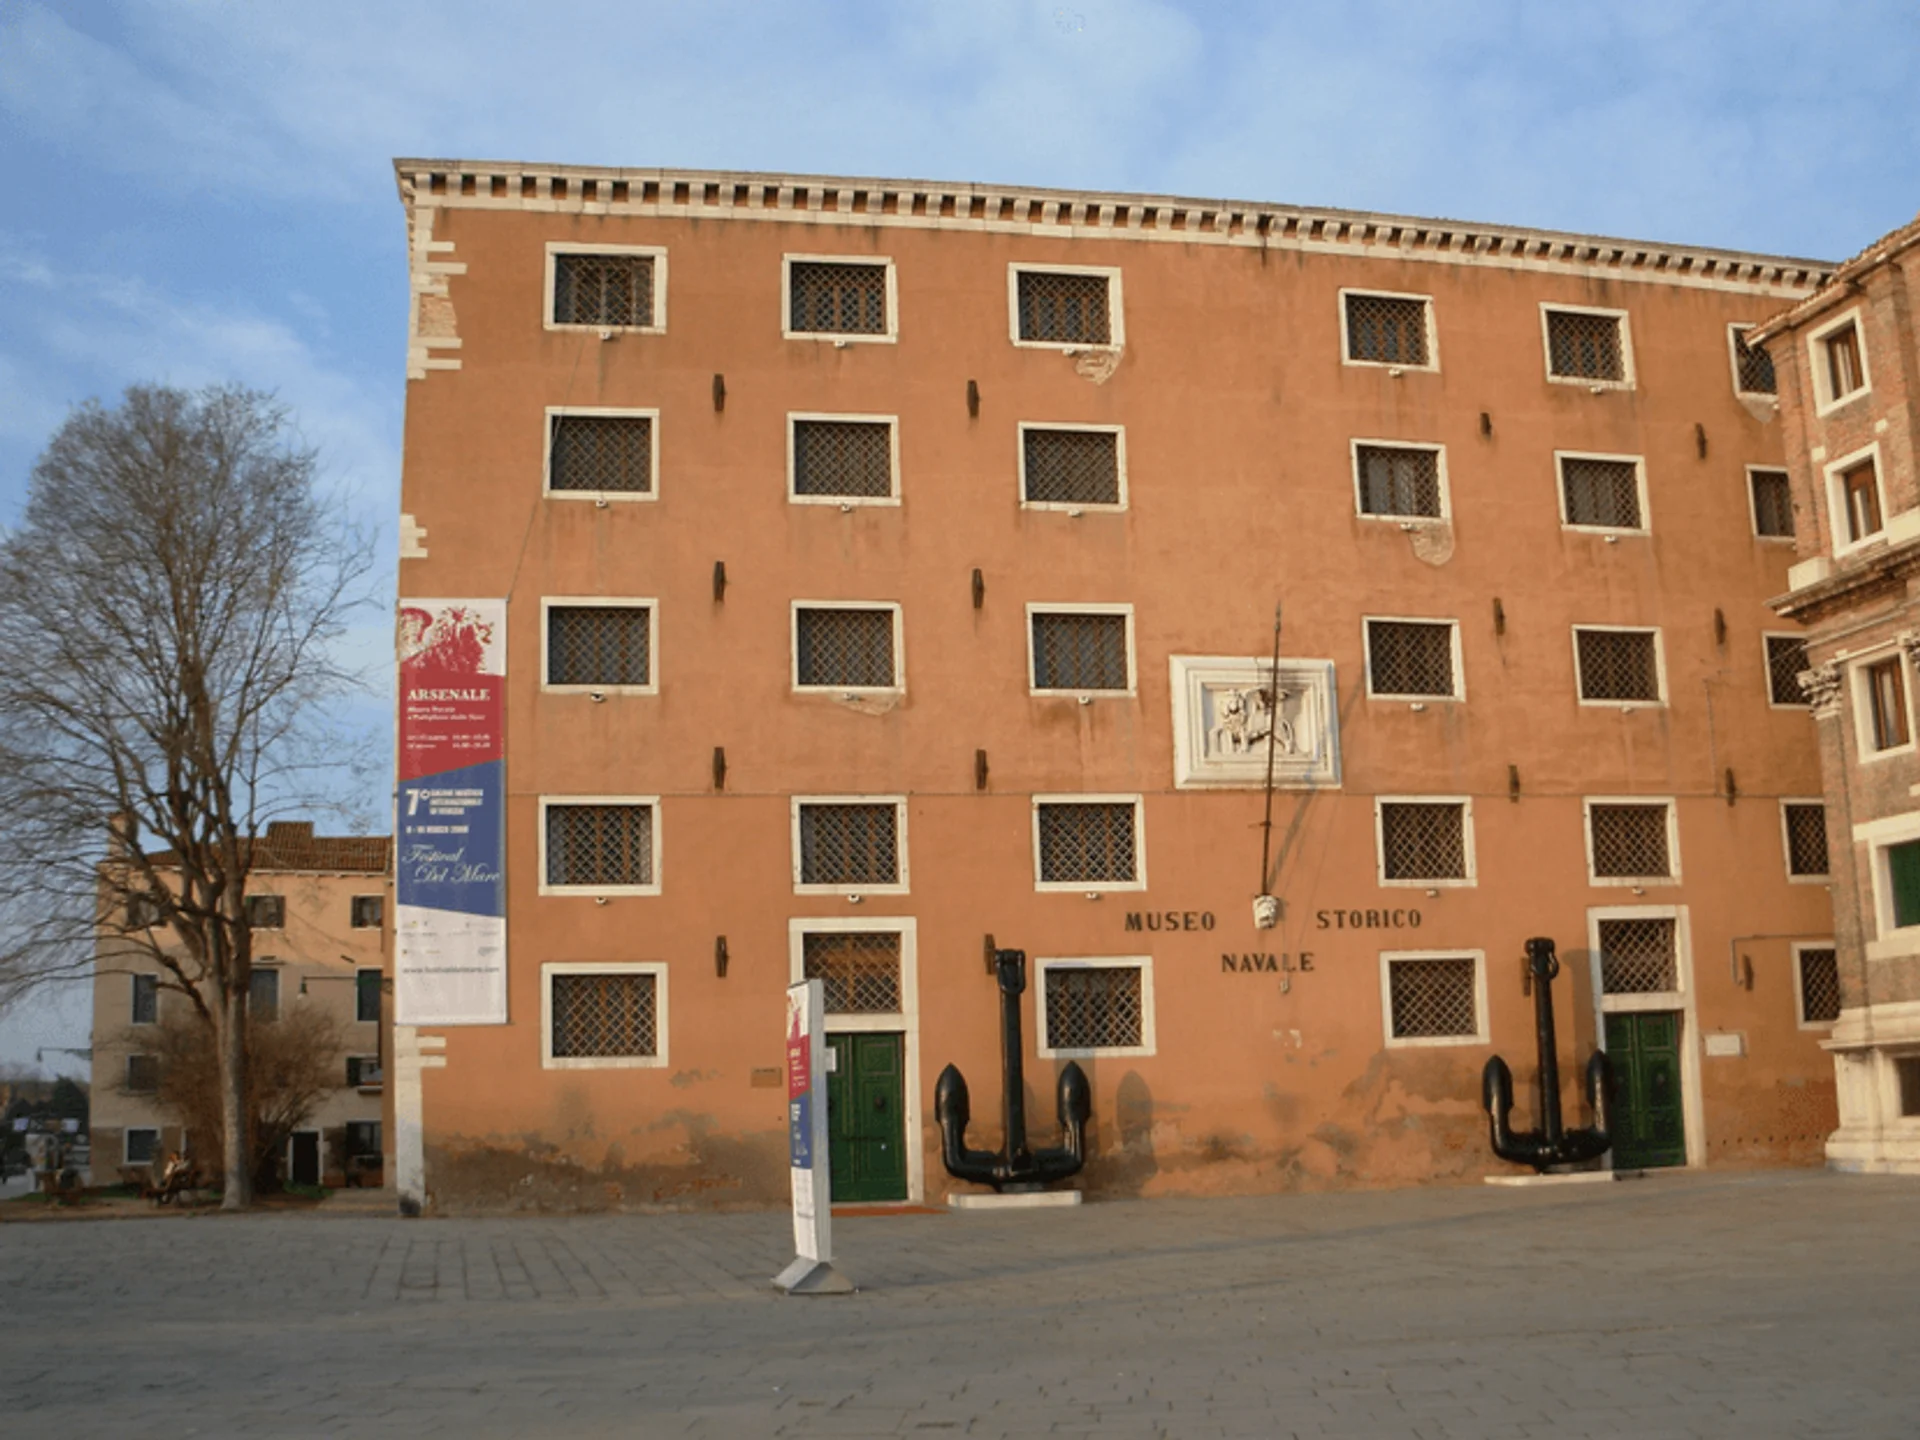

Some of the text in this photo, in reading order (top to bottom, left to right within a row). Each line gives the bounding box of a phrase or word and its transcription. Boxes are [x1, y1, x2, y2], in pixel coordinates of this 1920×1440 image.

[407, 688, 490, 701] ARSENALE
[1125, 909, 1422, 931] MUSEO STORICO
[1221, 952, 1315, 973] NAVALE
